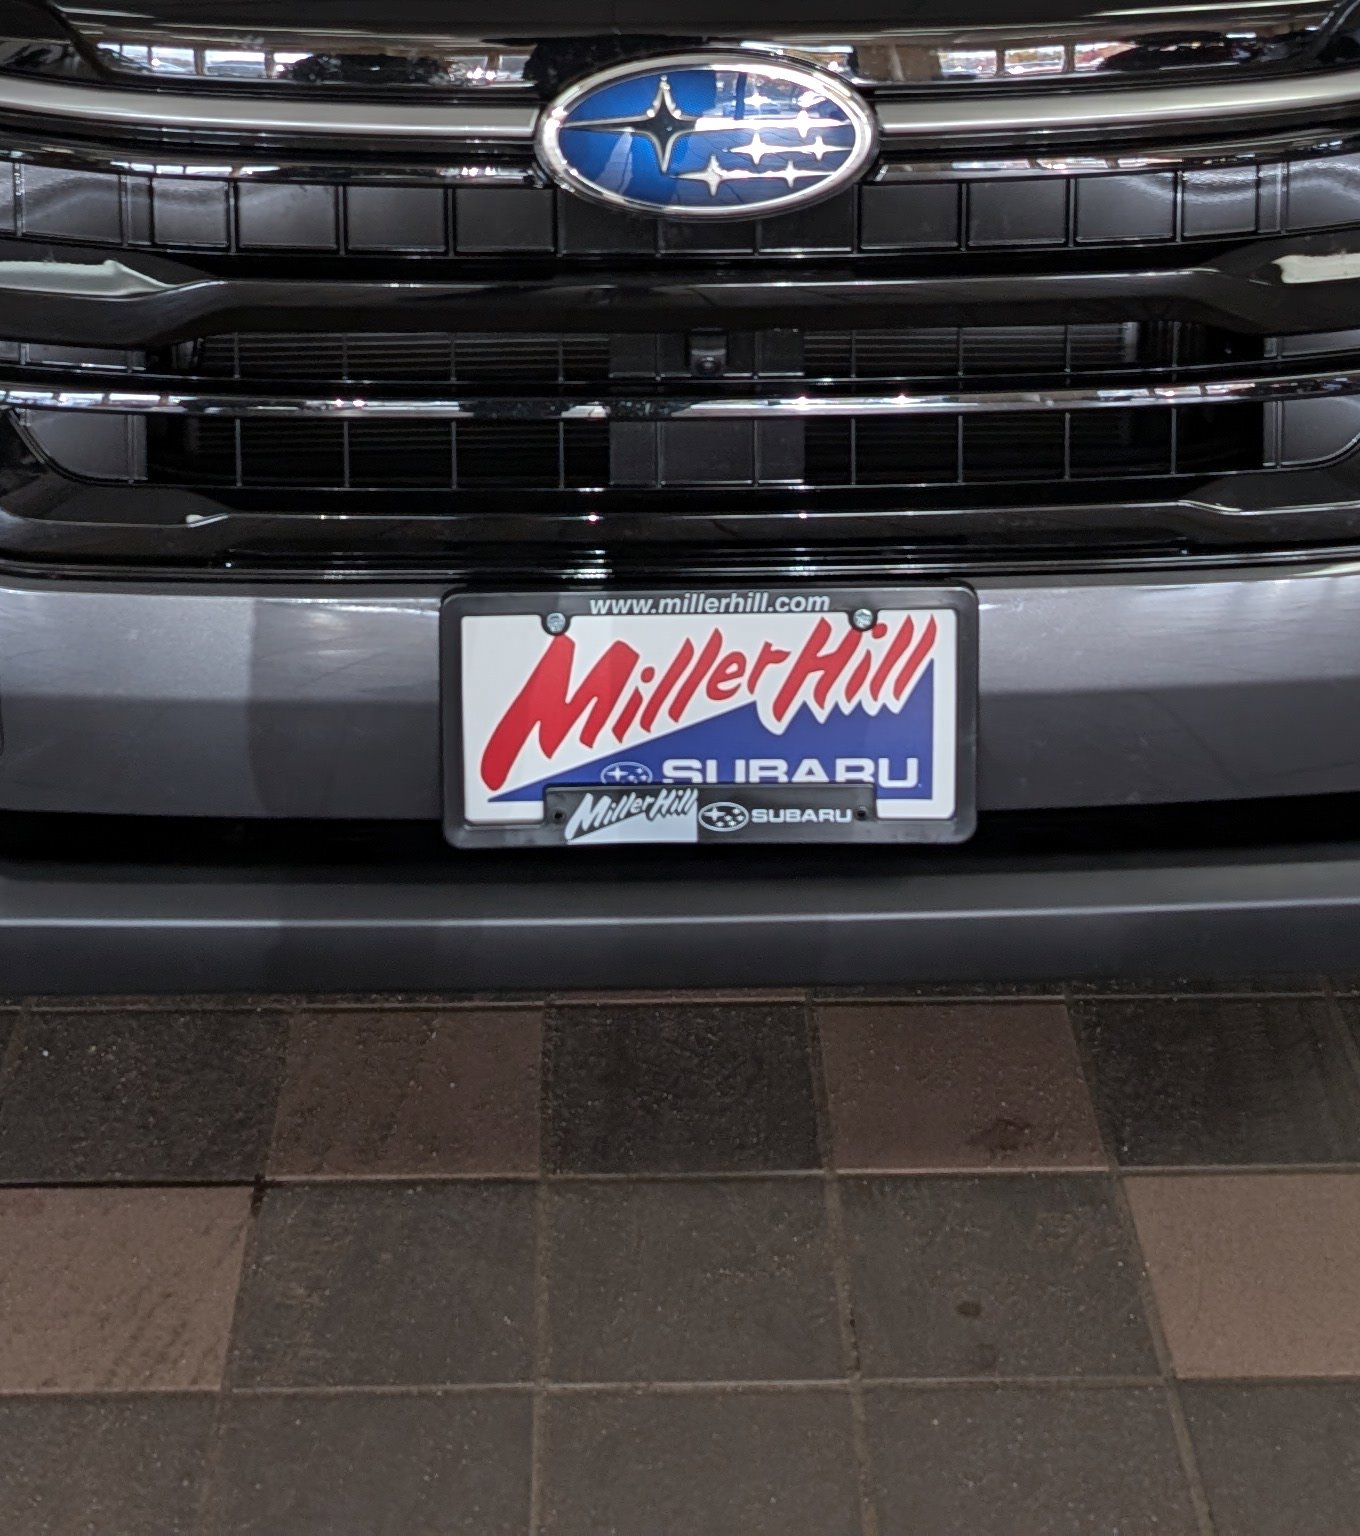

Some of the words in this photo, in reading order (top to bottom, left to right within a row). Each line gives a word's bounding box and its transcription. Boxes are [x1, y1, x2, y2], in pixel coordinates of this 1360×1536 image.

[589, 592, 831, 614] www.millerhill.com
[480, 628, 789, 791] Miller
[772, 615, 937, 723] Hill
[661, 758, 920, 788] SUBARU
[564, 791, 658, 841] Miller
[649, 788, 697, 821] Hill
[751, 808, 853, 824] SUBARU
